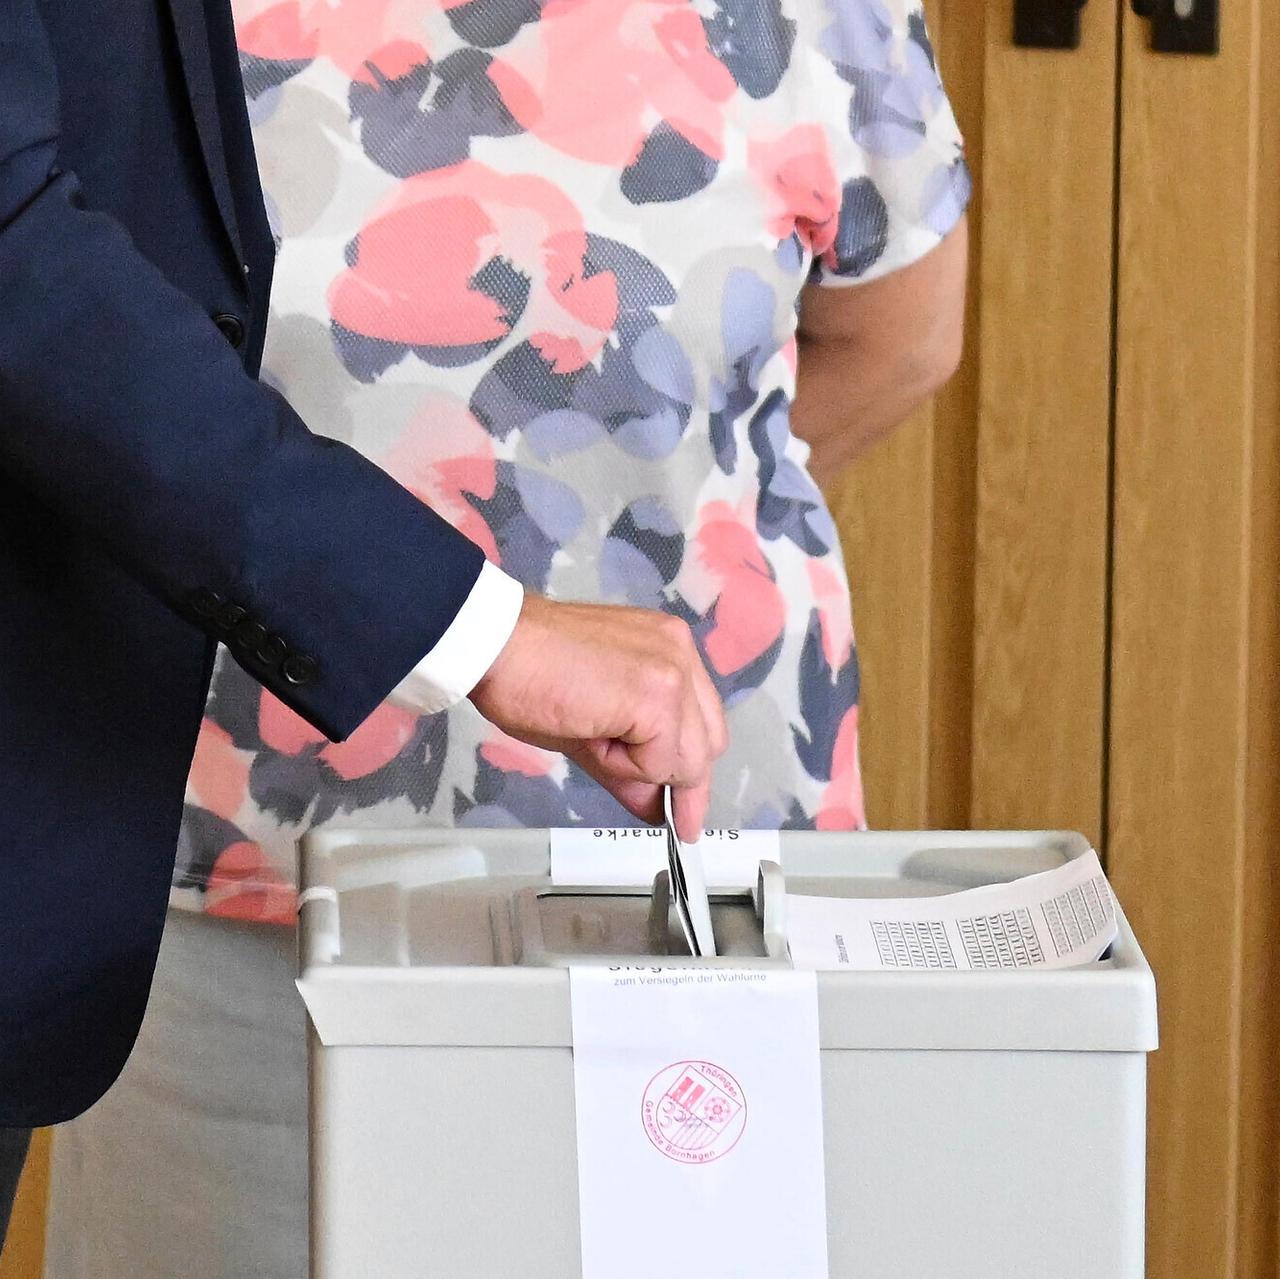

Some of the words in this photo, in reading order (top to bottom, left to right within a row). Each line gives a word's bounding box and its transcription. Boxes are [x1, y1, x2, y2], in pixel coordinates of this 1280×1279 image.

[614, 977, 636, 986] zum
[639, 974, 694, 986] Versiegeln
[697, 974, 713, 984] der
[717, 972, 767, 983] Wahlurne
[701, 1065, 738, 1097] Thüringen
[646, 1100, 664, 1145] Gemeinde
[665, 1145, 716, 1162] Bornhagen
